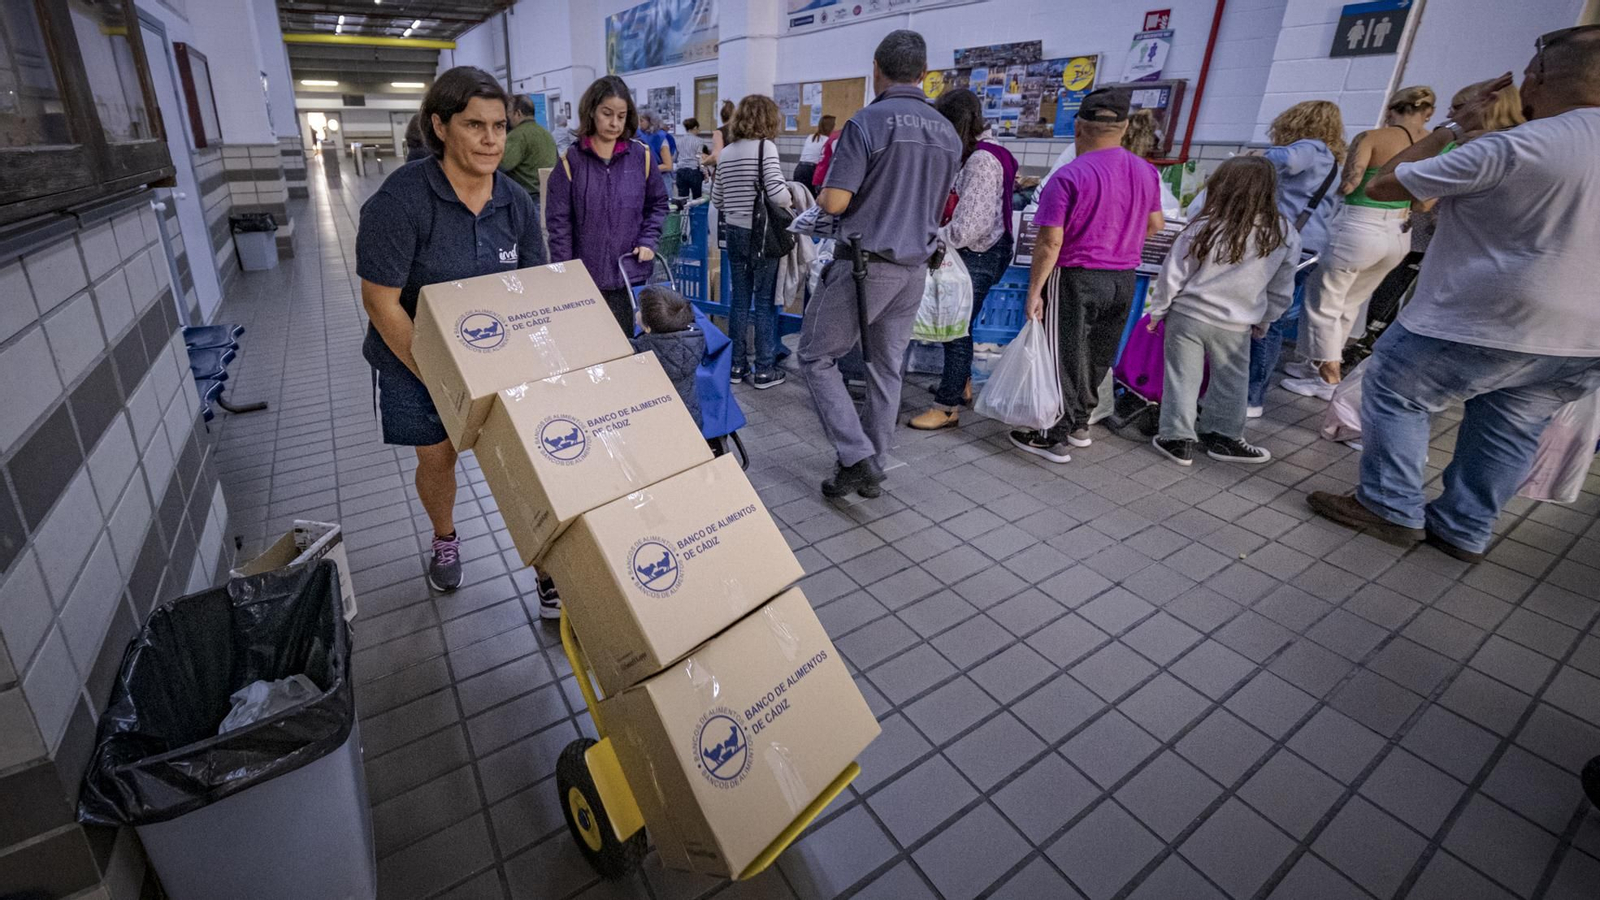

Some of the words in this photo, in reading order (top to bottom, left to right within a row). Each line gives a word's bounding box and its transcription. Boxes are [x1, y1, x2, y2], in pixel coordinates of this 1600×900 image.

[507, 309, 539, 322] BANCO
[540, 305, 552, 315] DE
[553, 298, 596, 313] ALIMENTOS
[511, 322, 525, 331] DE
[526, 316, 552, 328] CÁDIZ
[586, 413, 618, 428] BANCO
[617, 408, 631, 418] DE
[631, 394, 673, 413] ALIMENTOS
[605, 418, 631, 433] CÁDIZ
[676, 529, 706, 550] BANCO
[706, 523, 718, 534] DE
[717, 504, 757, 529] ALIMENTOS
[683, 550, 696, 561] DE
[695, 536, 721, 554] CÁDIZ
[744, 692, 775, 721] BANCO
[774, 682, 787, 698] DE
[786, 650, 828, 689] ALIMENTOS
[751, 719, 766, 735] DE
[764, 698, 791, 724] CÁDIZ
